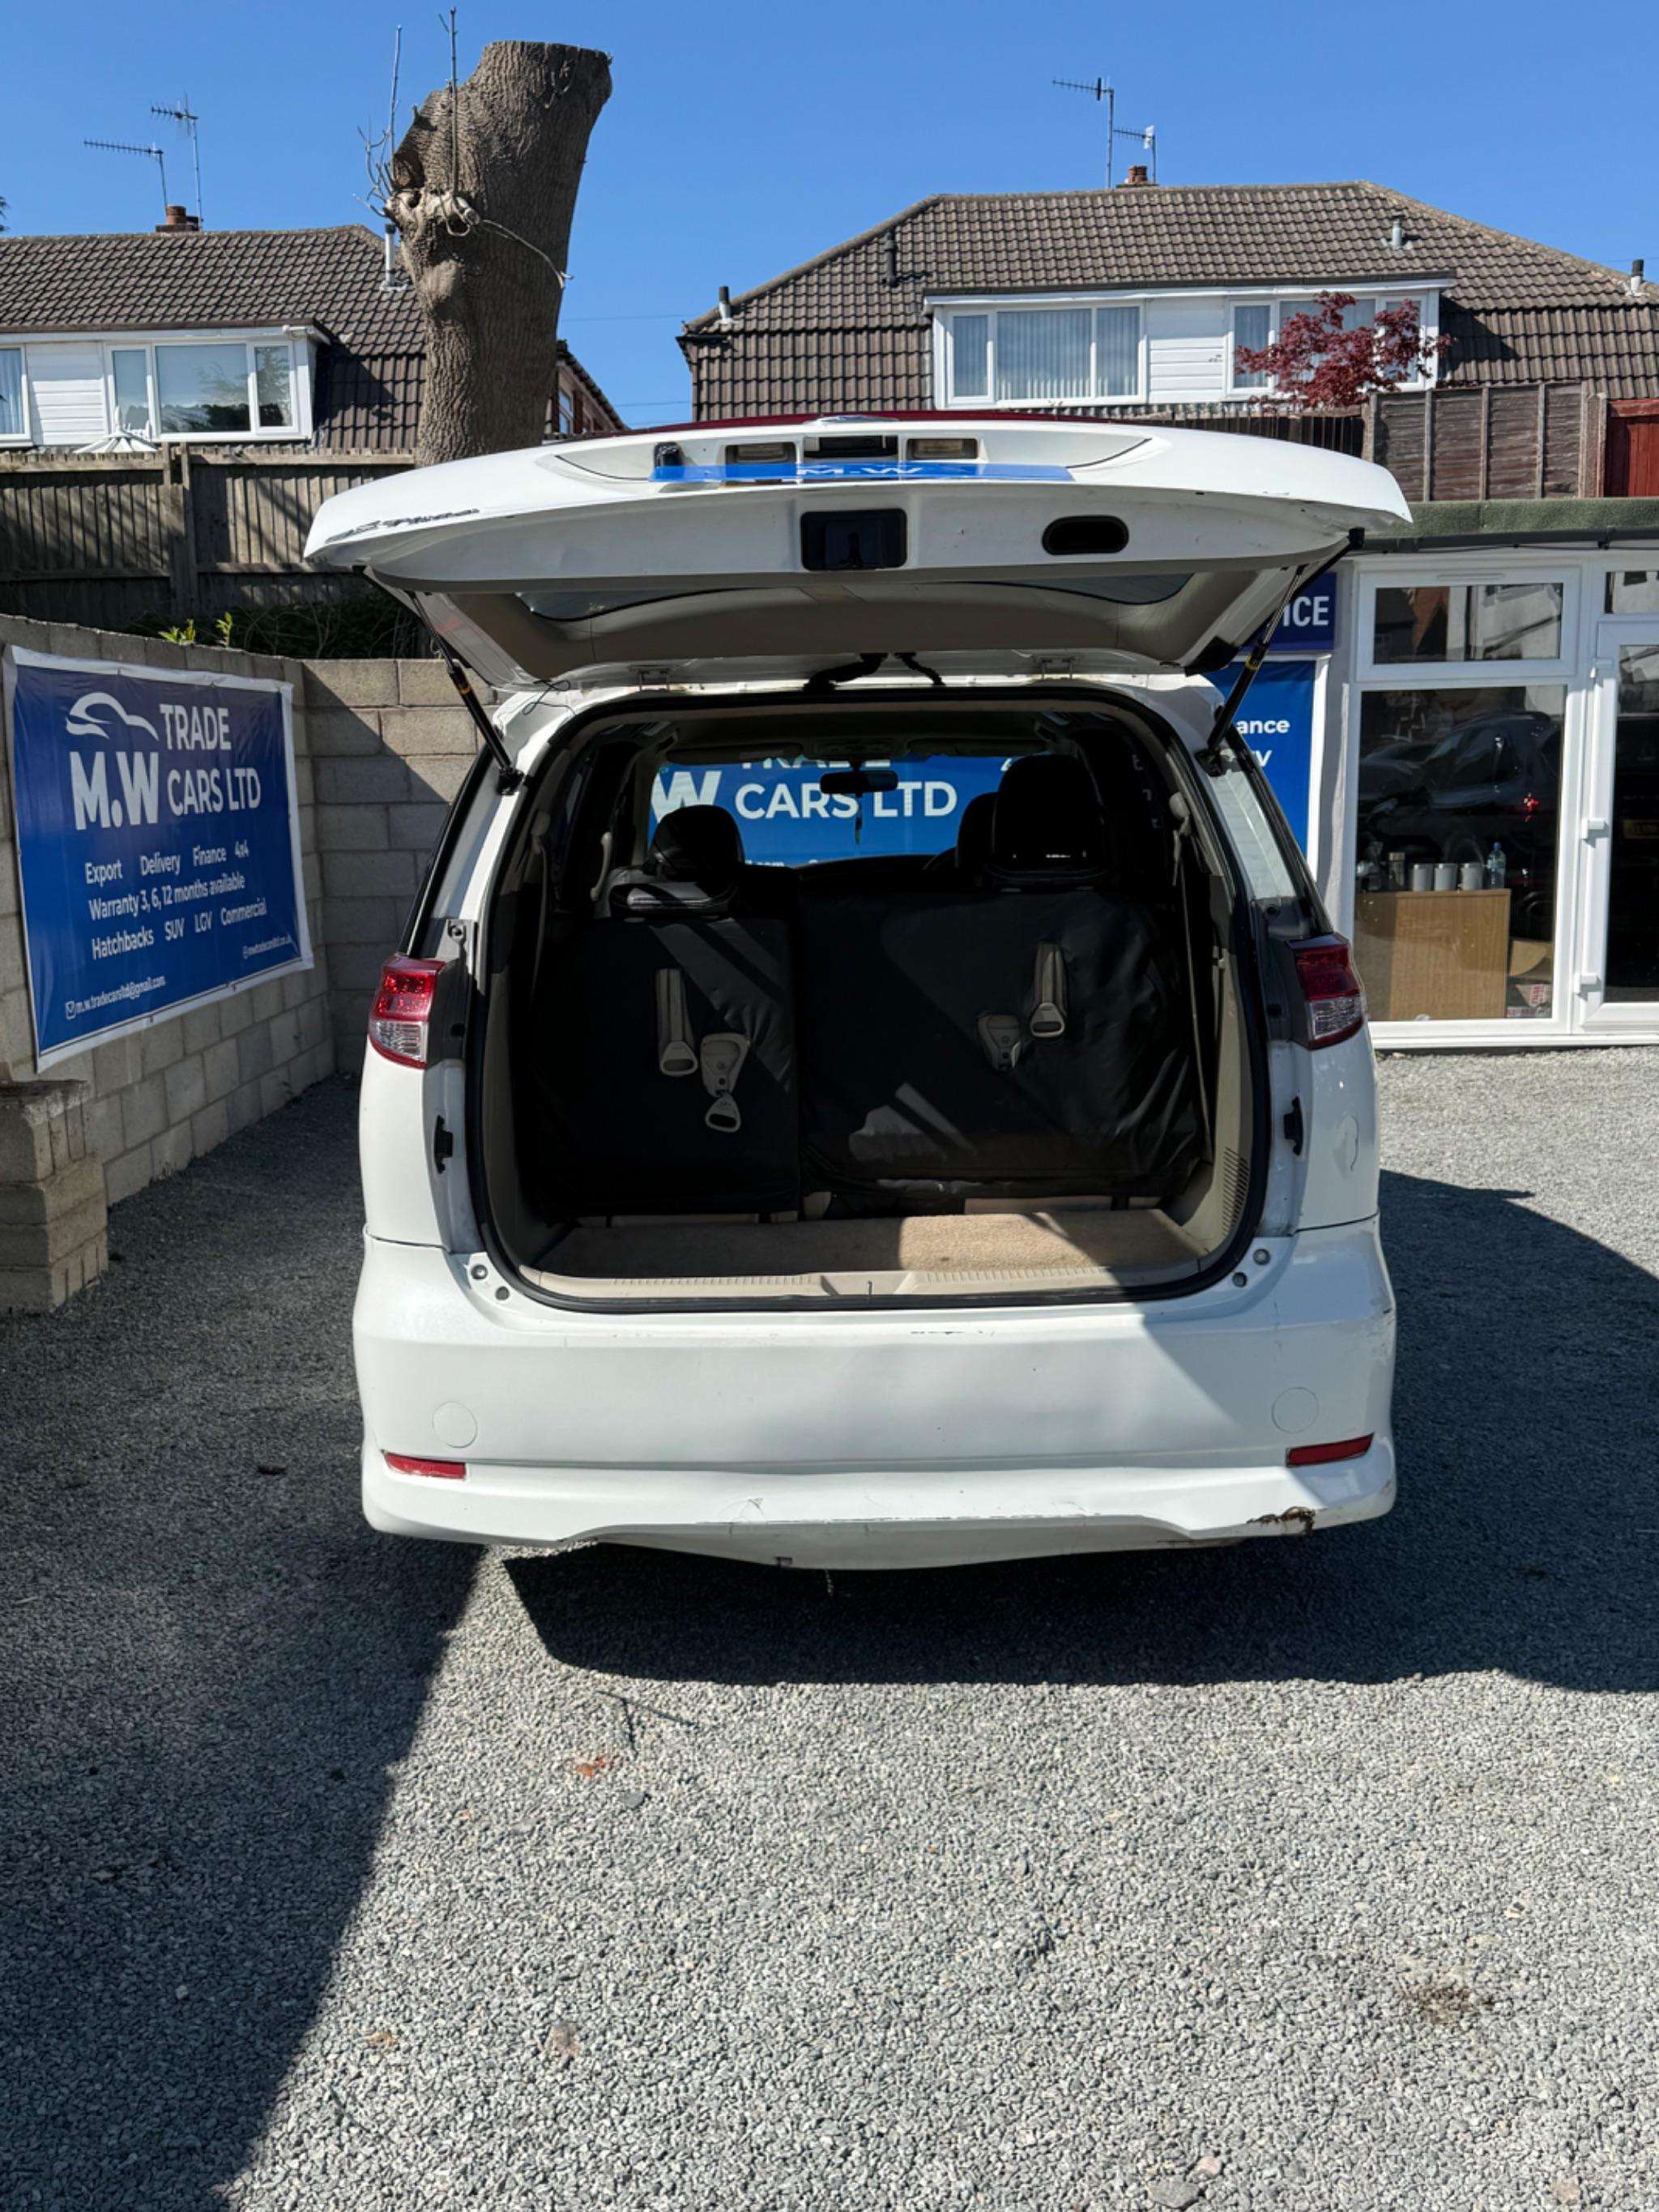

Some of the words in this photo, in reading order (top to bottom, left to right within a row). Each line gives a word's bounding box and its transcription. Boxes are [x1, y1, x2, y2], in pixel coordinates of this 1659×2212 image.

[1282, 596, 1329, 627] ICE
[159, 703, 232, 750] TRADE
[70, 751, 160, 831] M.W
[167, 768, 224, 817] CARS
[226, 767, 261, 810] LTD
[735, 783, 859, 819] CARS
[873, 781, 957, 818] LTD
[85, 860, 122, 888] Export
[140, 852, 181, 876] Delivery
[193, 845, 227, 867] Finance
[235, 839, 249, 858] 4x4
[88, 893, 139, 921] Warranty
[140, 890, 151, 913] 3,
[151, 888, 162, 911] 6,
[161, 884, 173, 905] 12
[173, 878, 209, 903] months
[210, 871, 245, 895] available
[92, 925, 155, 960] Hatchbacks
[164, 917, 186, 941] SUV
[194, 911, 213, 933] LGV
[220, 898, 267, 926] Commercial
